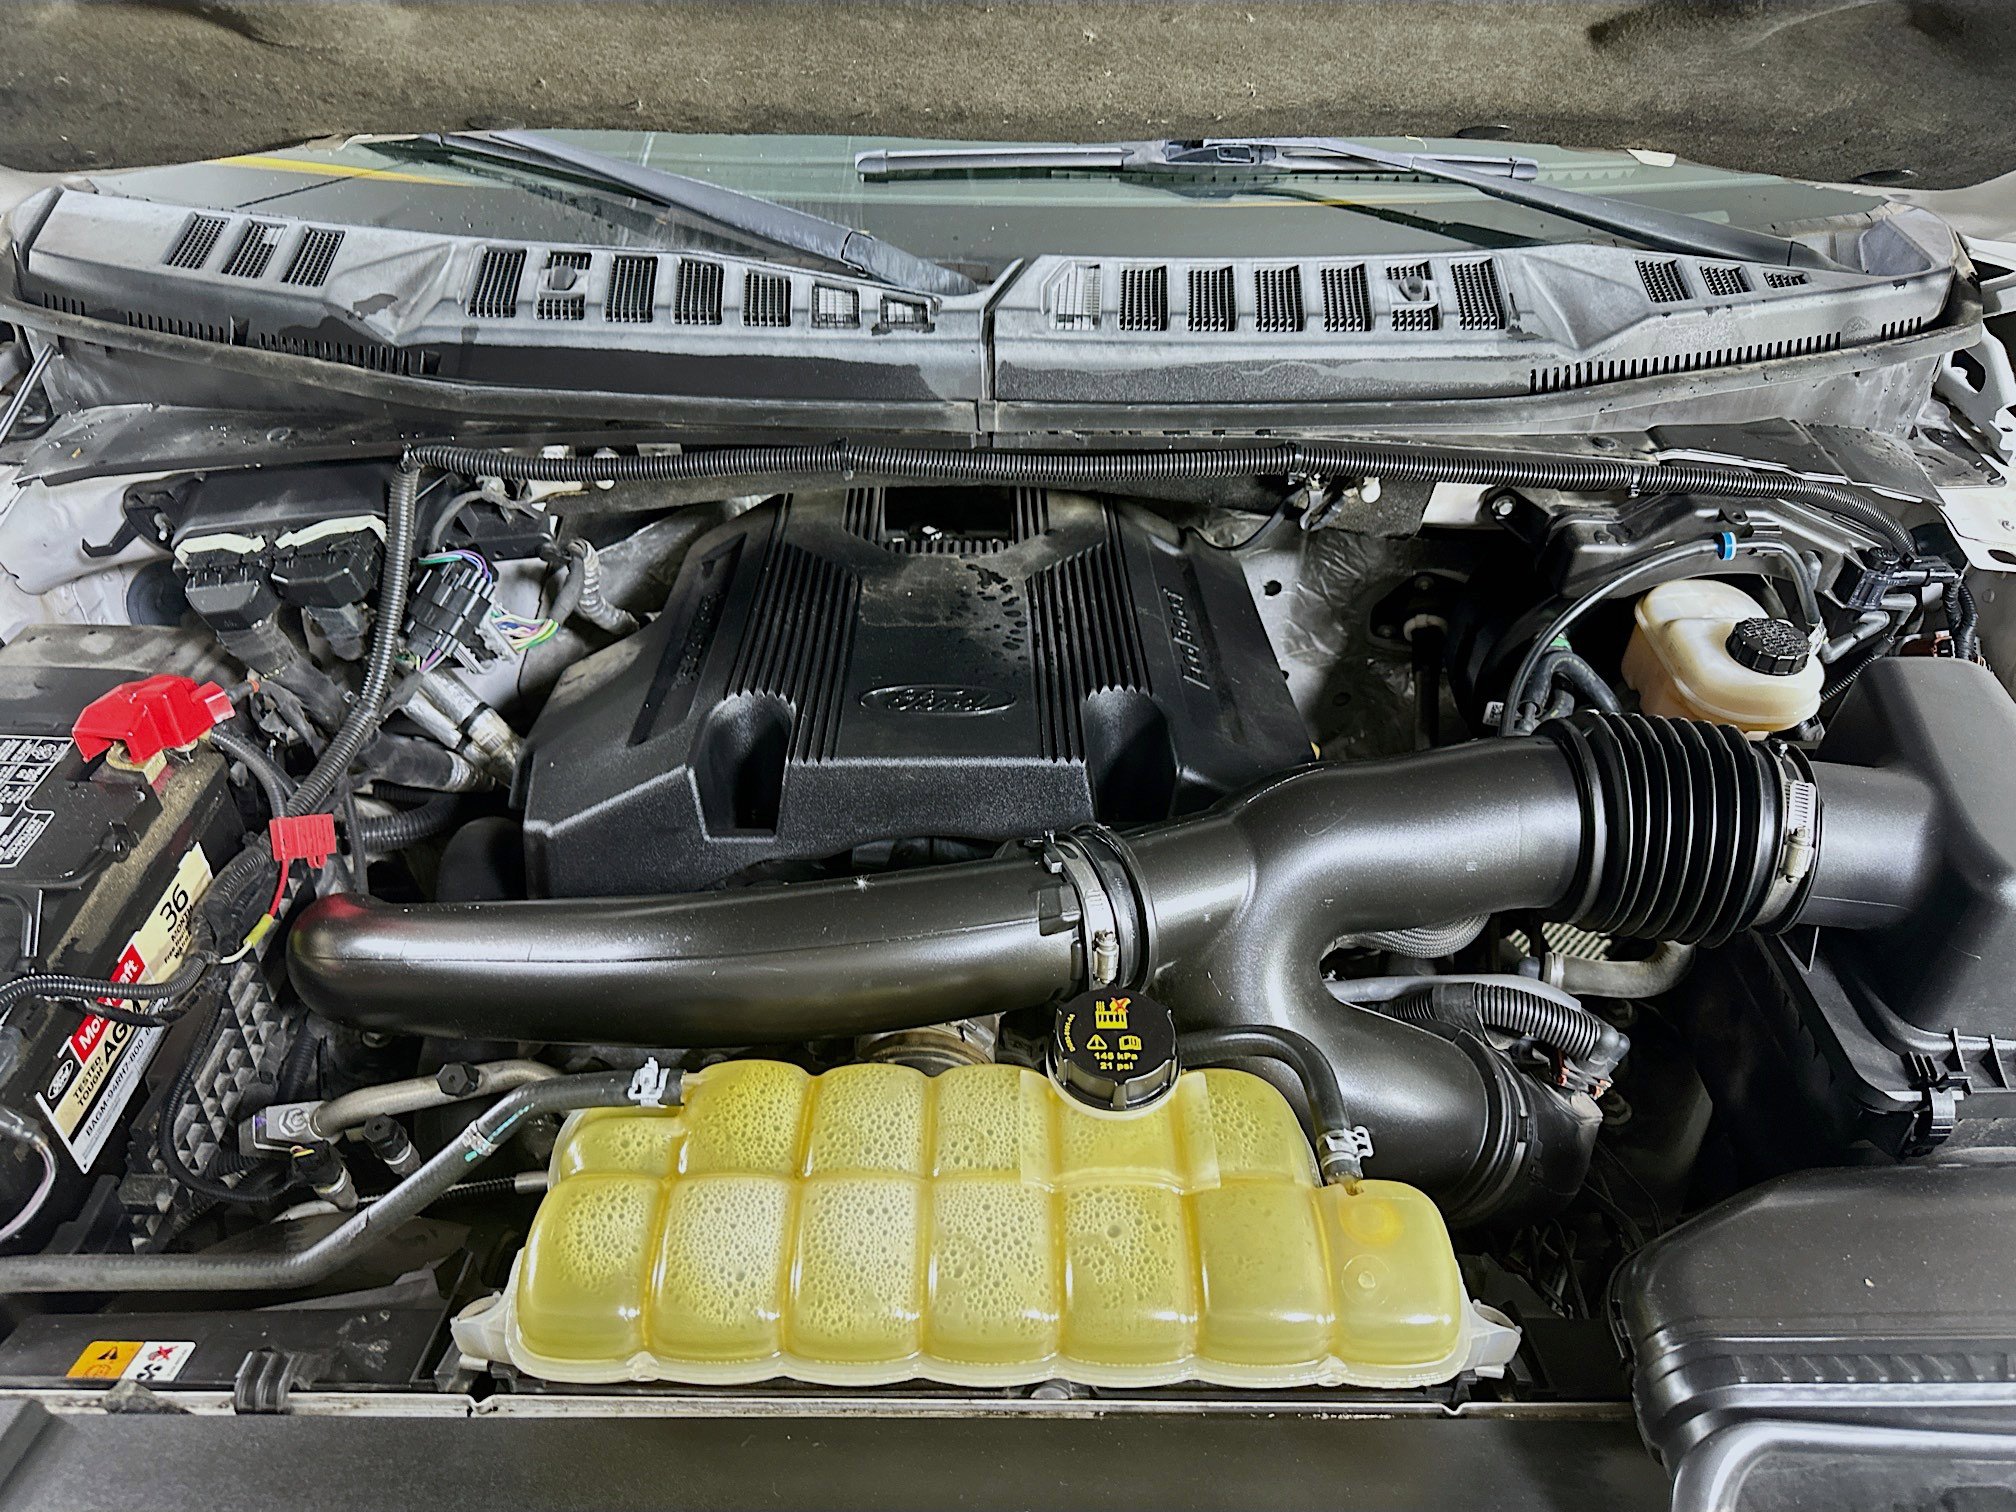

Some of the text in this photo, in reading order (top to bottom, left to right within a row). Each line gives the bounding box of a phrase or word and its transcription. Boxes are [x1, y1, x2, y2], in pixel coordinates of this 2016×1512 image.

[875, 687, 1002, 714] Ford
[160, 883, 189, 933] 36
[171, 904, 194, 942] MONTH
[1100, 1061, 1134, 1072] 21 psi
[1117, 1052, 1138, 1061] kPa
[51, 1063, 72, 1096] Ford
[73, 1056, 101, 1099] TESTED
